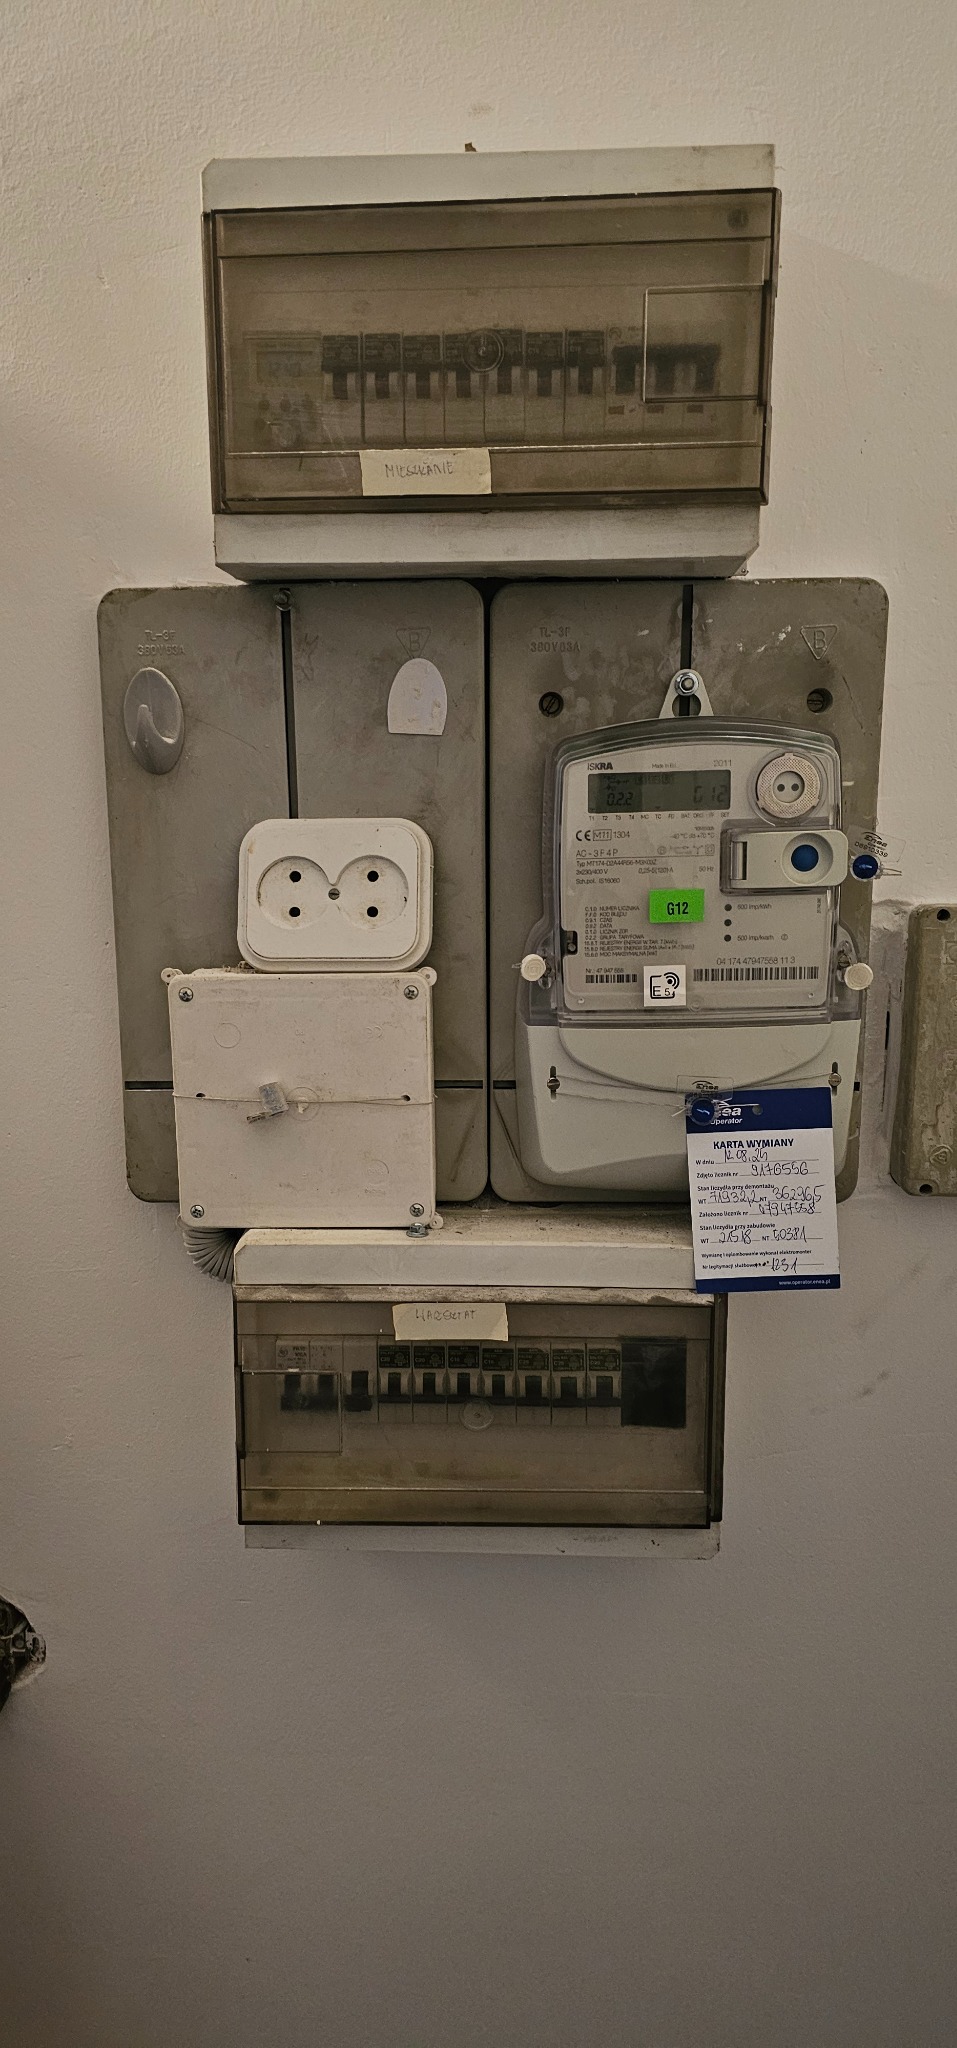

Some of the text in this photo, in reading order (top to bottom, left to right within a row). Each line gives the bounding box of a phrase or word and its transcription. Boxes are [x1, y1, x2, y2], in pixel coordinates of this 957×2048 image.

[813, 629, 826, 650] B
[587, 762, 614, 771] ISKRA
[713, 759, 732, 767] 2011
[613, 831, 630, 839] 1304
[575, 849, 587, 858] AC
[593, 849, 599, 857] 3
[613, 848, 619, 856] P
[698, 865, 706, 873] 50
[666, 901, 689, 915] G12
[716, 957, 726, 966] 04
[728, 957, 741, 965] 174
[790, 956, 796, 964] 3
[713, 1138, 794, 1150] KARTA WYMIANY
[696, 1171, 714, 1179] Zdjęto
[744, 1182, 775, 1190] demontażu
[708, 1263, 734, 1271] legitymacji
[778, 1278, 831, 1286] www.operator.enea.pl
